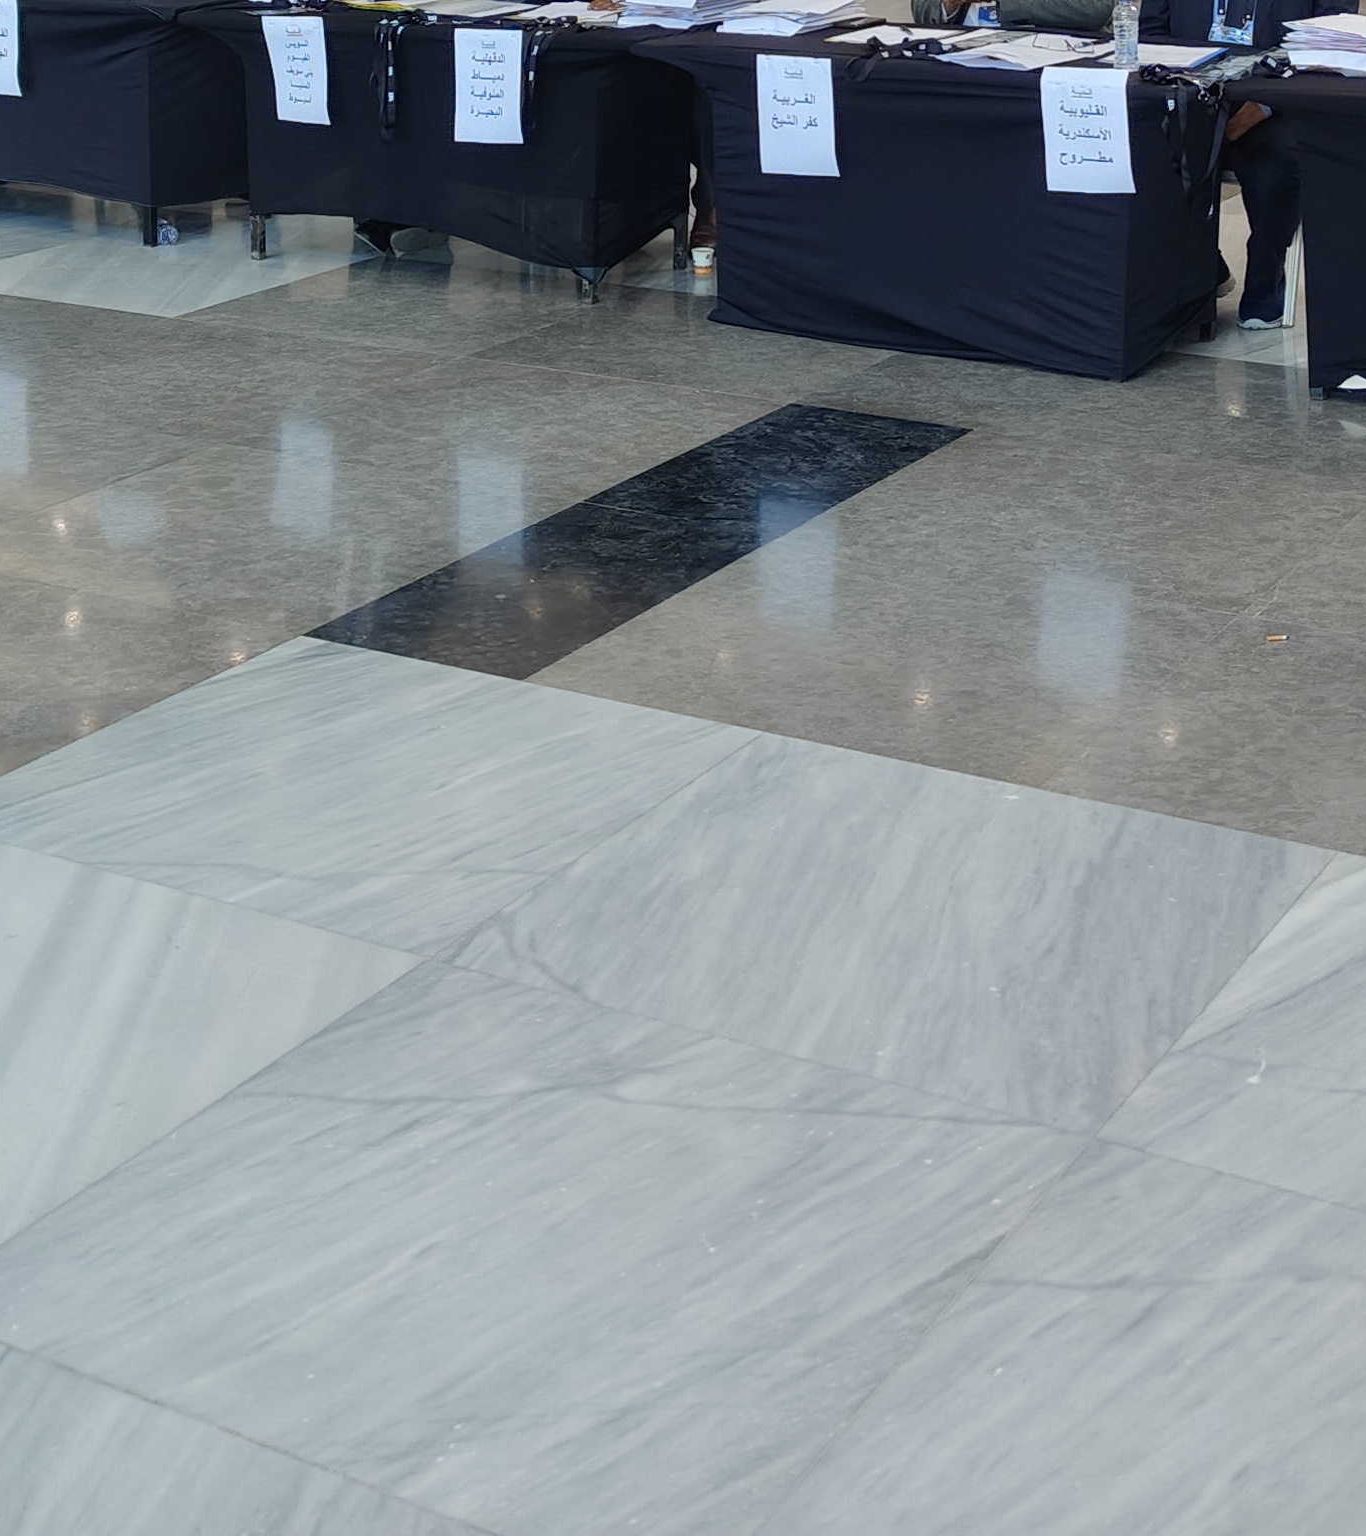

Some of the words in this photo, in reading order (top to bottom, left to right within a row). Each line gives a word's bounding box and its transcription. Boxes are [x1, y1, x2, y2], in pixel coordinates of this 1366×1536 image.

[470, 86, 504, 101] المنوفية
[772, 89, 815, 106] الغربية
[470, 104, 503, 118] البحيرة
[1059, 100, 1108, 118] القليوبية
[771, 113, 798, 129] الشيخ
[803, 115, 818, 130] كفر
[1059, 150, 1114, 165] مطروح
